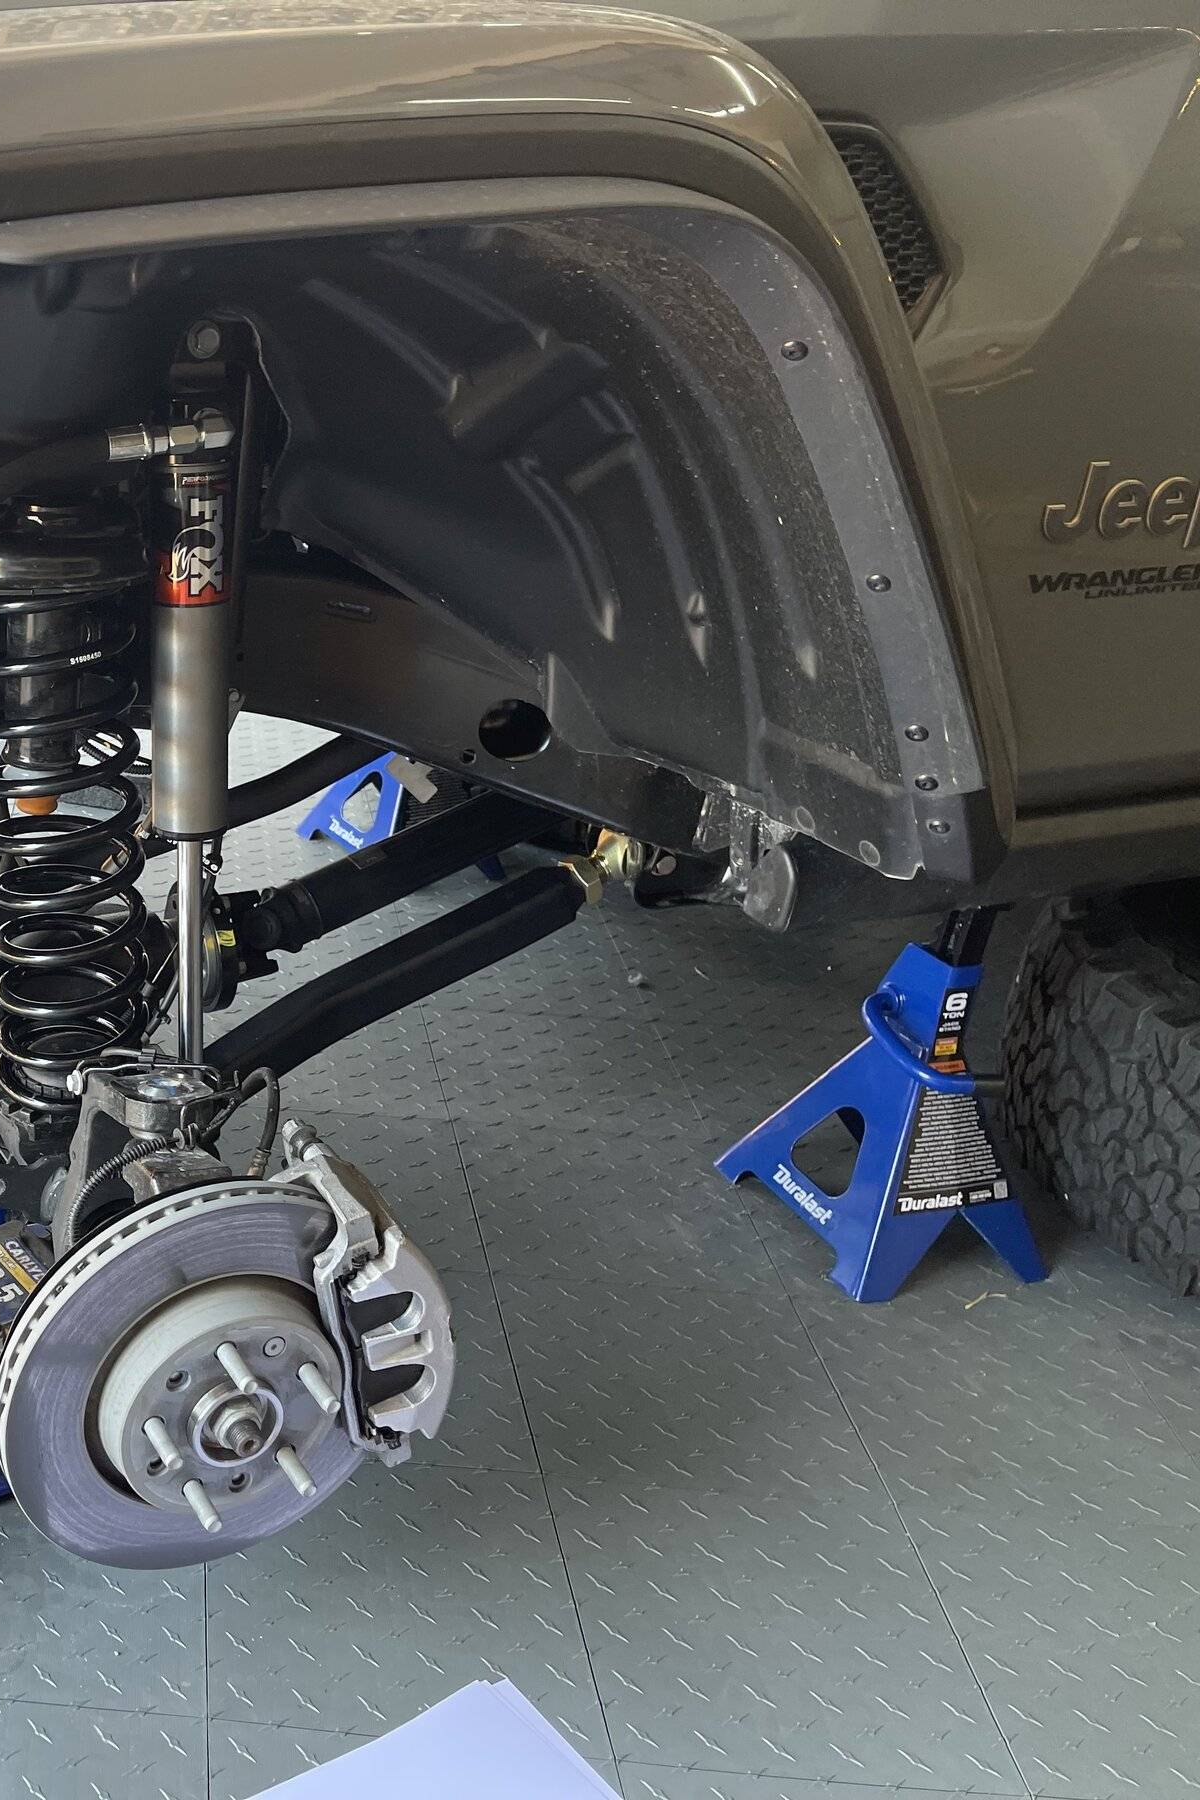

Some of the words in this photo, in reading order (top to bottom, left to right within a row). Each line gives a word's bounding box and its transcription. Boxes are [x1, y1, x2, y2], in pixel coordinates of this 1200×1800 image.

[172, 495, 224, 595] FOX
[942, 1011, 965, 1019] TON
[945, 992, 969, 1012] 6
[773, 1163, 833, 1225] Duralast
[898, 1191, 963, 1212] Duralast
[4, 1240, 45, 1281] CARLYL
